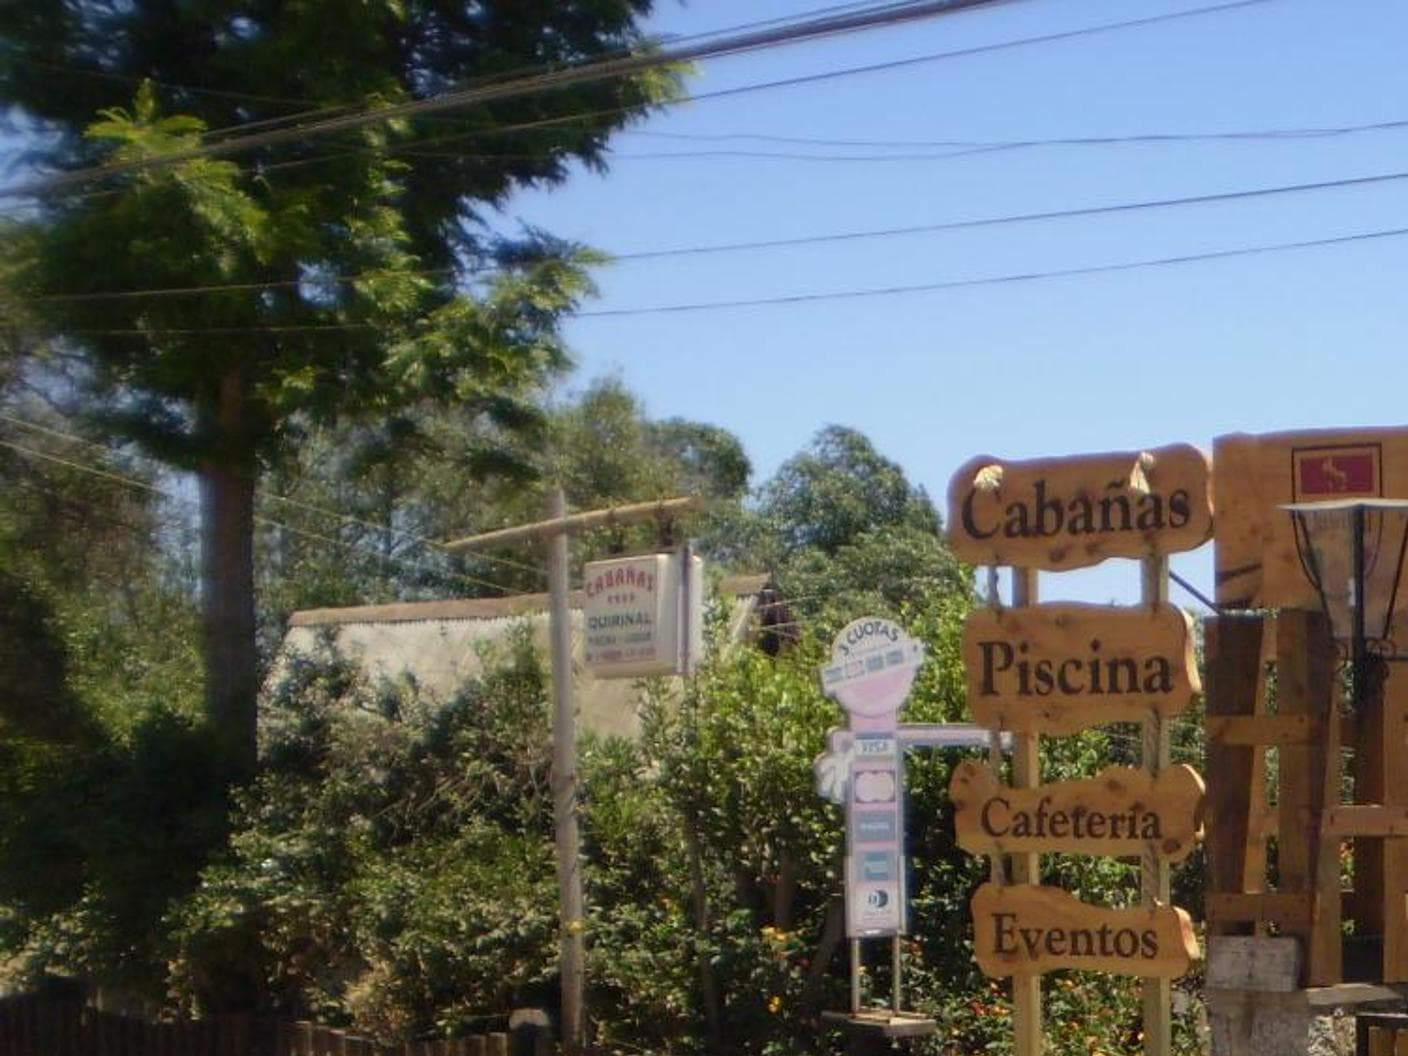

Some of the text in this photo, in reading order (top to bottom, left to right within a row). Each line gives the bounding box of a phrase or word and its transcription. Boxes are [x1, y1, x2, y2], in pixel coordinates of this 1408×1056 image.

[961, 479, 1190, 540] Cabañas
[846, 620, 900, 645] CUOTAS
[978, 638, 1174, 697] Piscina
[991, 912, 1159, 961] Eventos
